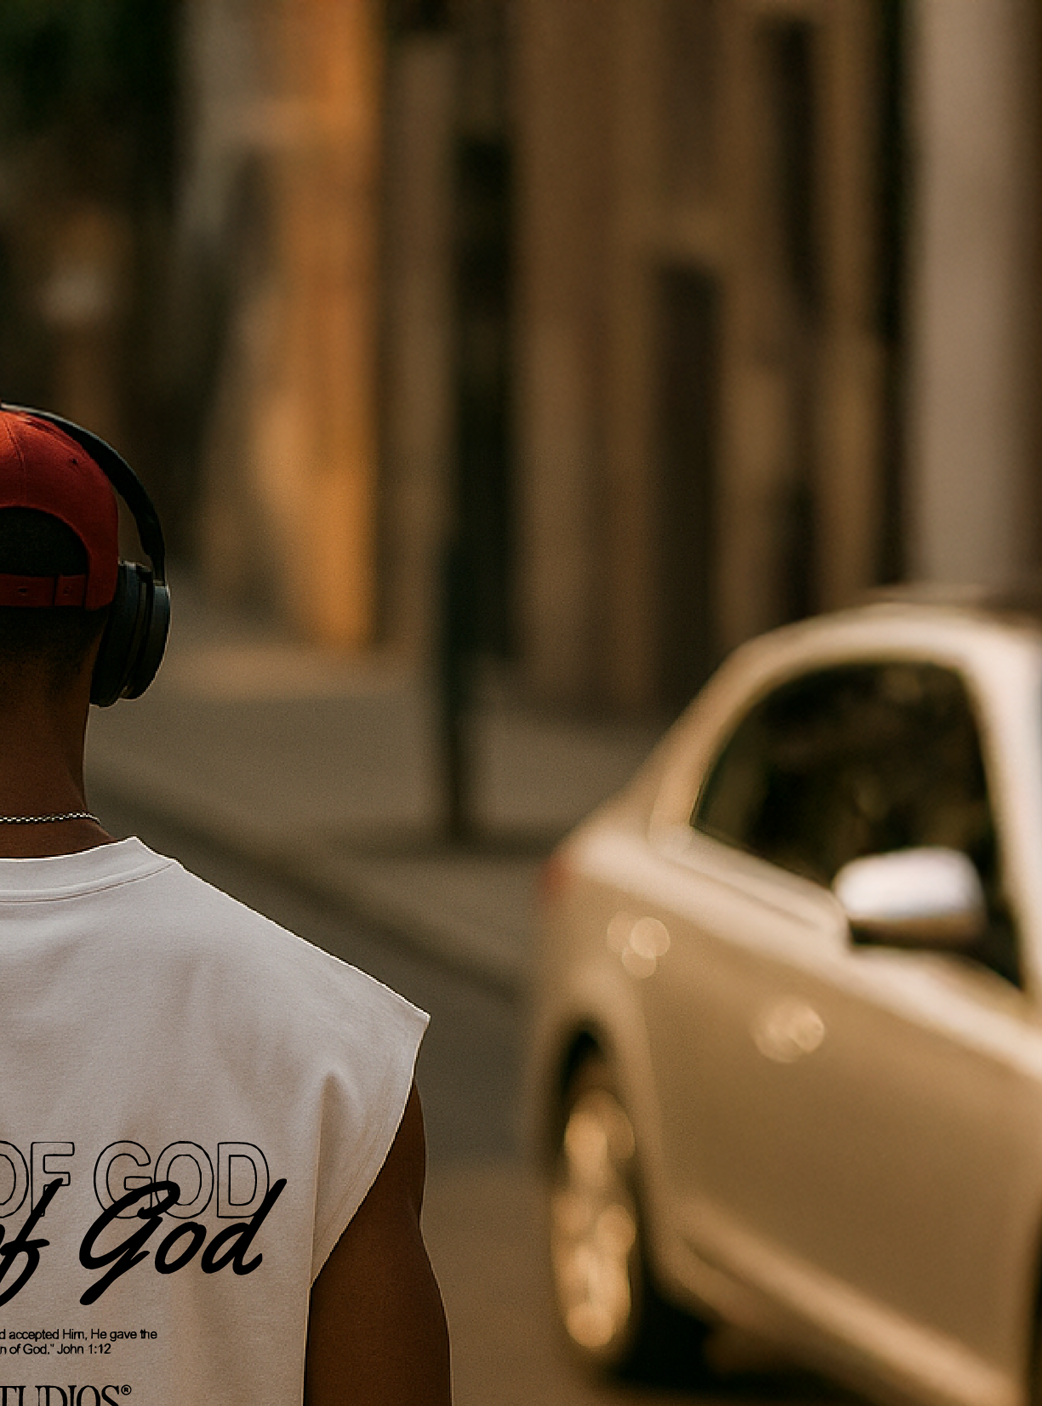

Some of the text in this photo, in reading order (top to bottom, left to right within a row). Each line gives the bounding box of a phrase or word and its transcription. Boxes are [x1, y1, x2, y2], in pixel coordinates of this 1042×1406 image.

[93, 1140, 271, 1219] GOD
[79, 1178, 288, 1305] God
[9, 1329, 59, 1342] accepted
[62, 1329, 88, 1341] Him,
[90, 1329, 107, 1340] He
[110, 1331, 137, 1342] gave
[140, 1329, 158, 1340] the
[9, 1344, 21, 1355] of
[57, 1344, 84, 1355] John
[88, 1343, 112, 1355] 1:12
